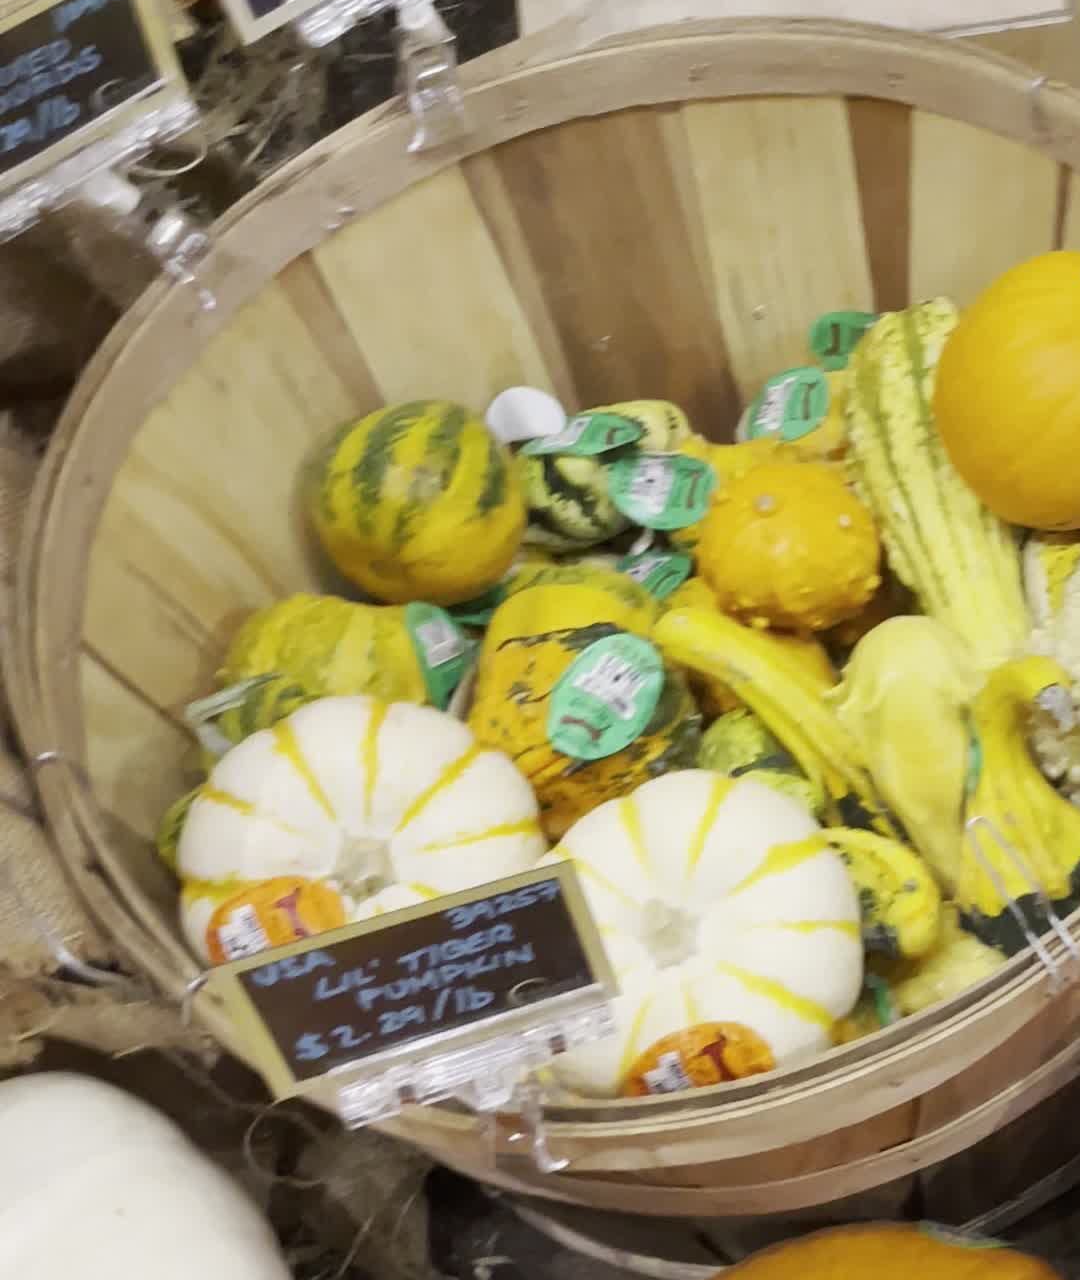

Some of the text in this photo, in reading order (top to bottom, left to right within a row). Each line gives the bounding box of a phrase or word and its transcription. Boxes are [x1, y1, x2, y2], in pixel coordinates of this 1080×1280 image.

[250, 950, 336, 988] USA
[398, 924, 516, 973] TIGER
[357, 942, 535, 1012] PUMPKIN
